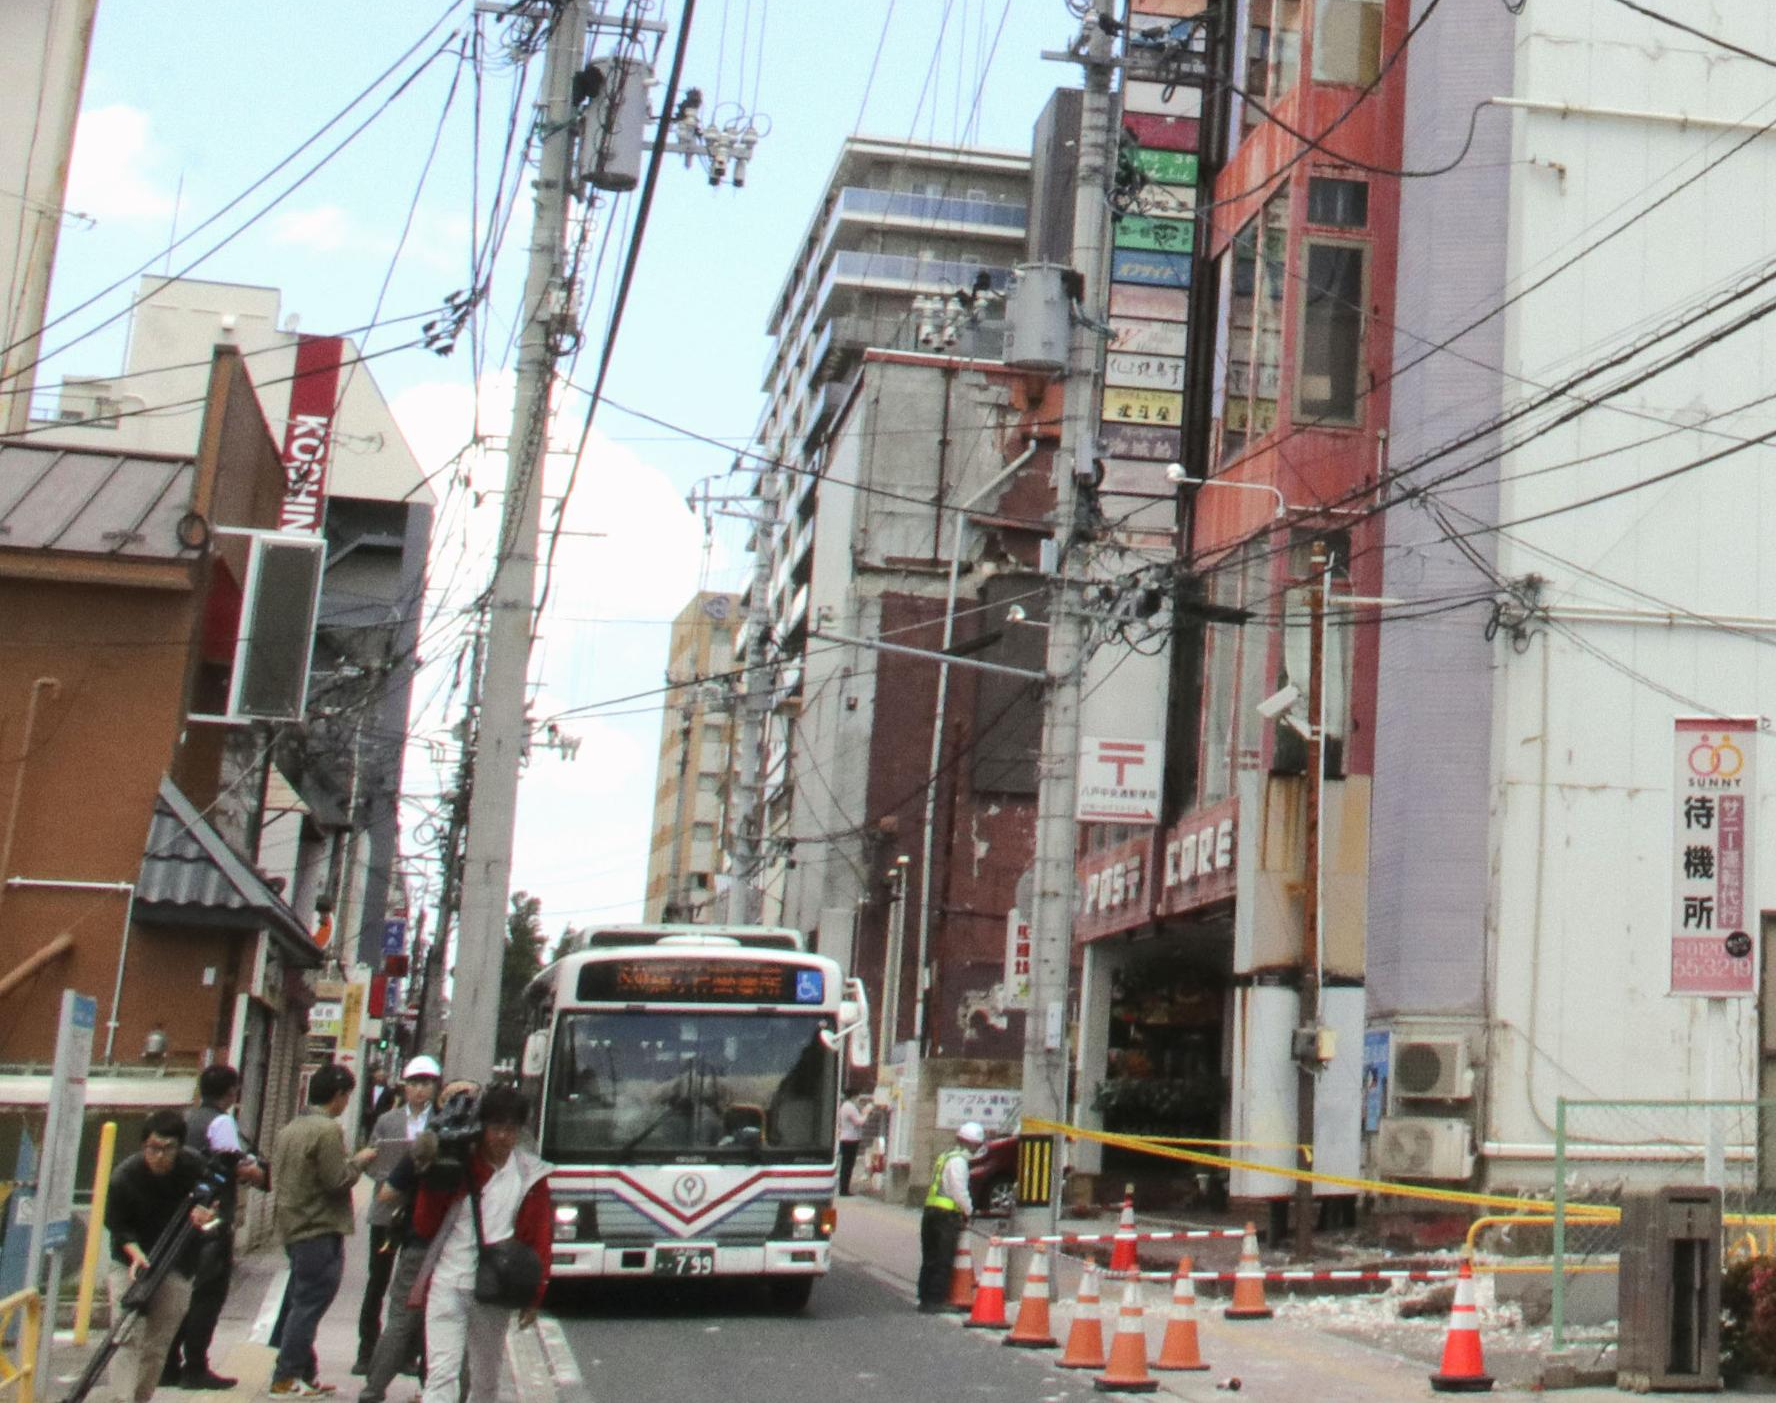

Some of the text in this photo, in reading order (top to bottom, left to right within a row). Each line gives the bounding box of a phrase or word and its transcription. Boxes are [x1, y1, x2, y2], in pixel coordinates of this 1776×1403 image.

[1688, 777, 1742, 788] SUNNY
[1085, 855, 1141, 915] POST
[1165, 818, 1233, 887] CORE
[1684, 795, 1714, 931] 待機所
[1720, 797, 1742, 925] サニー運転代行
